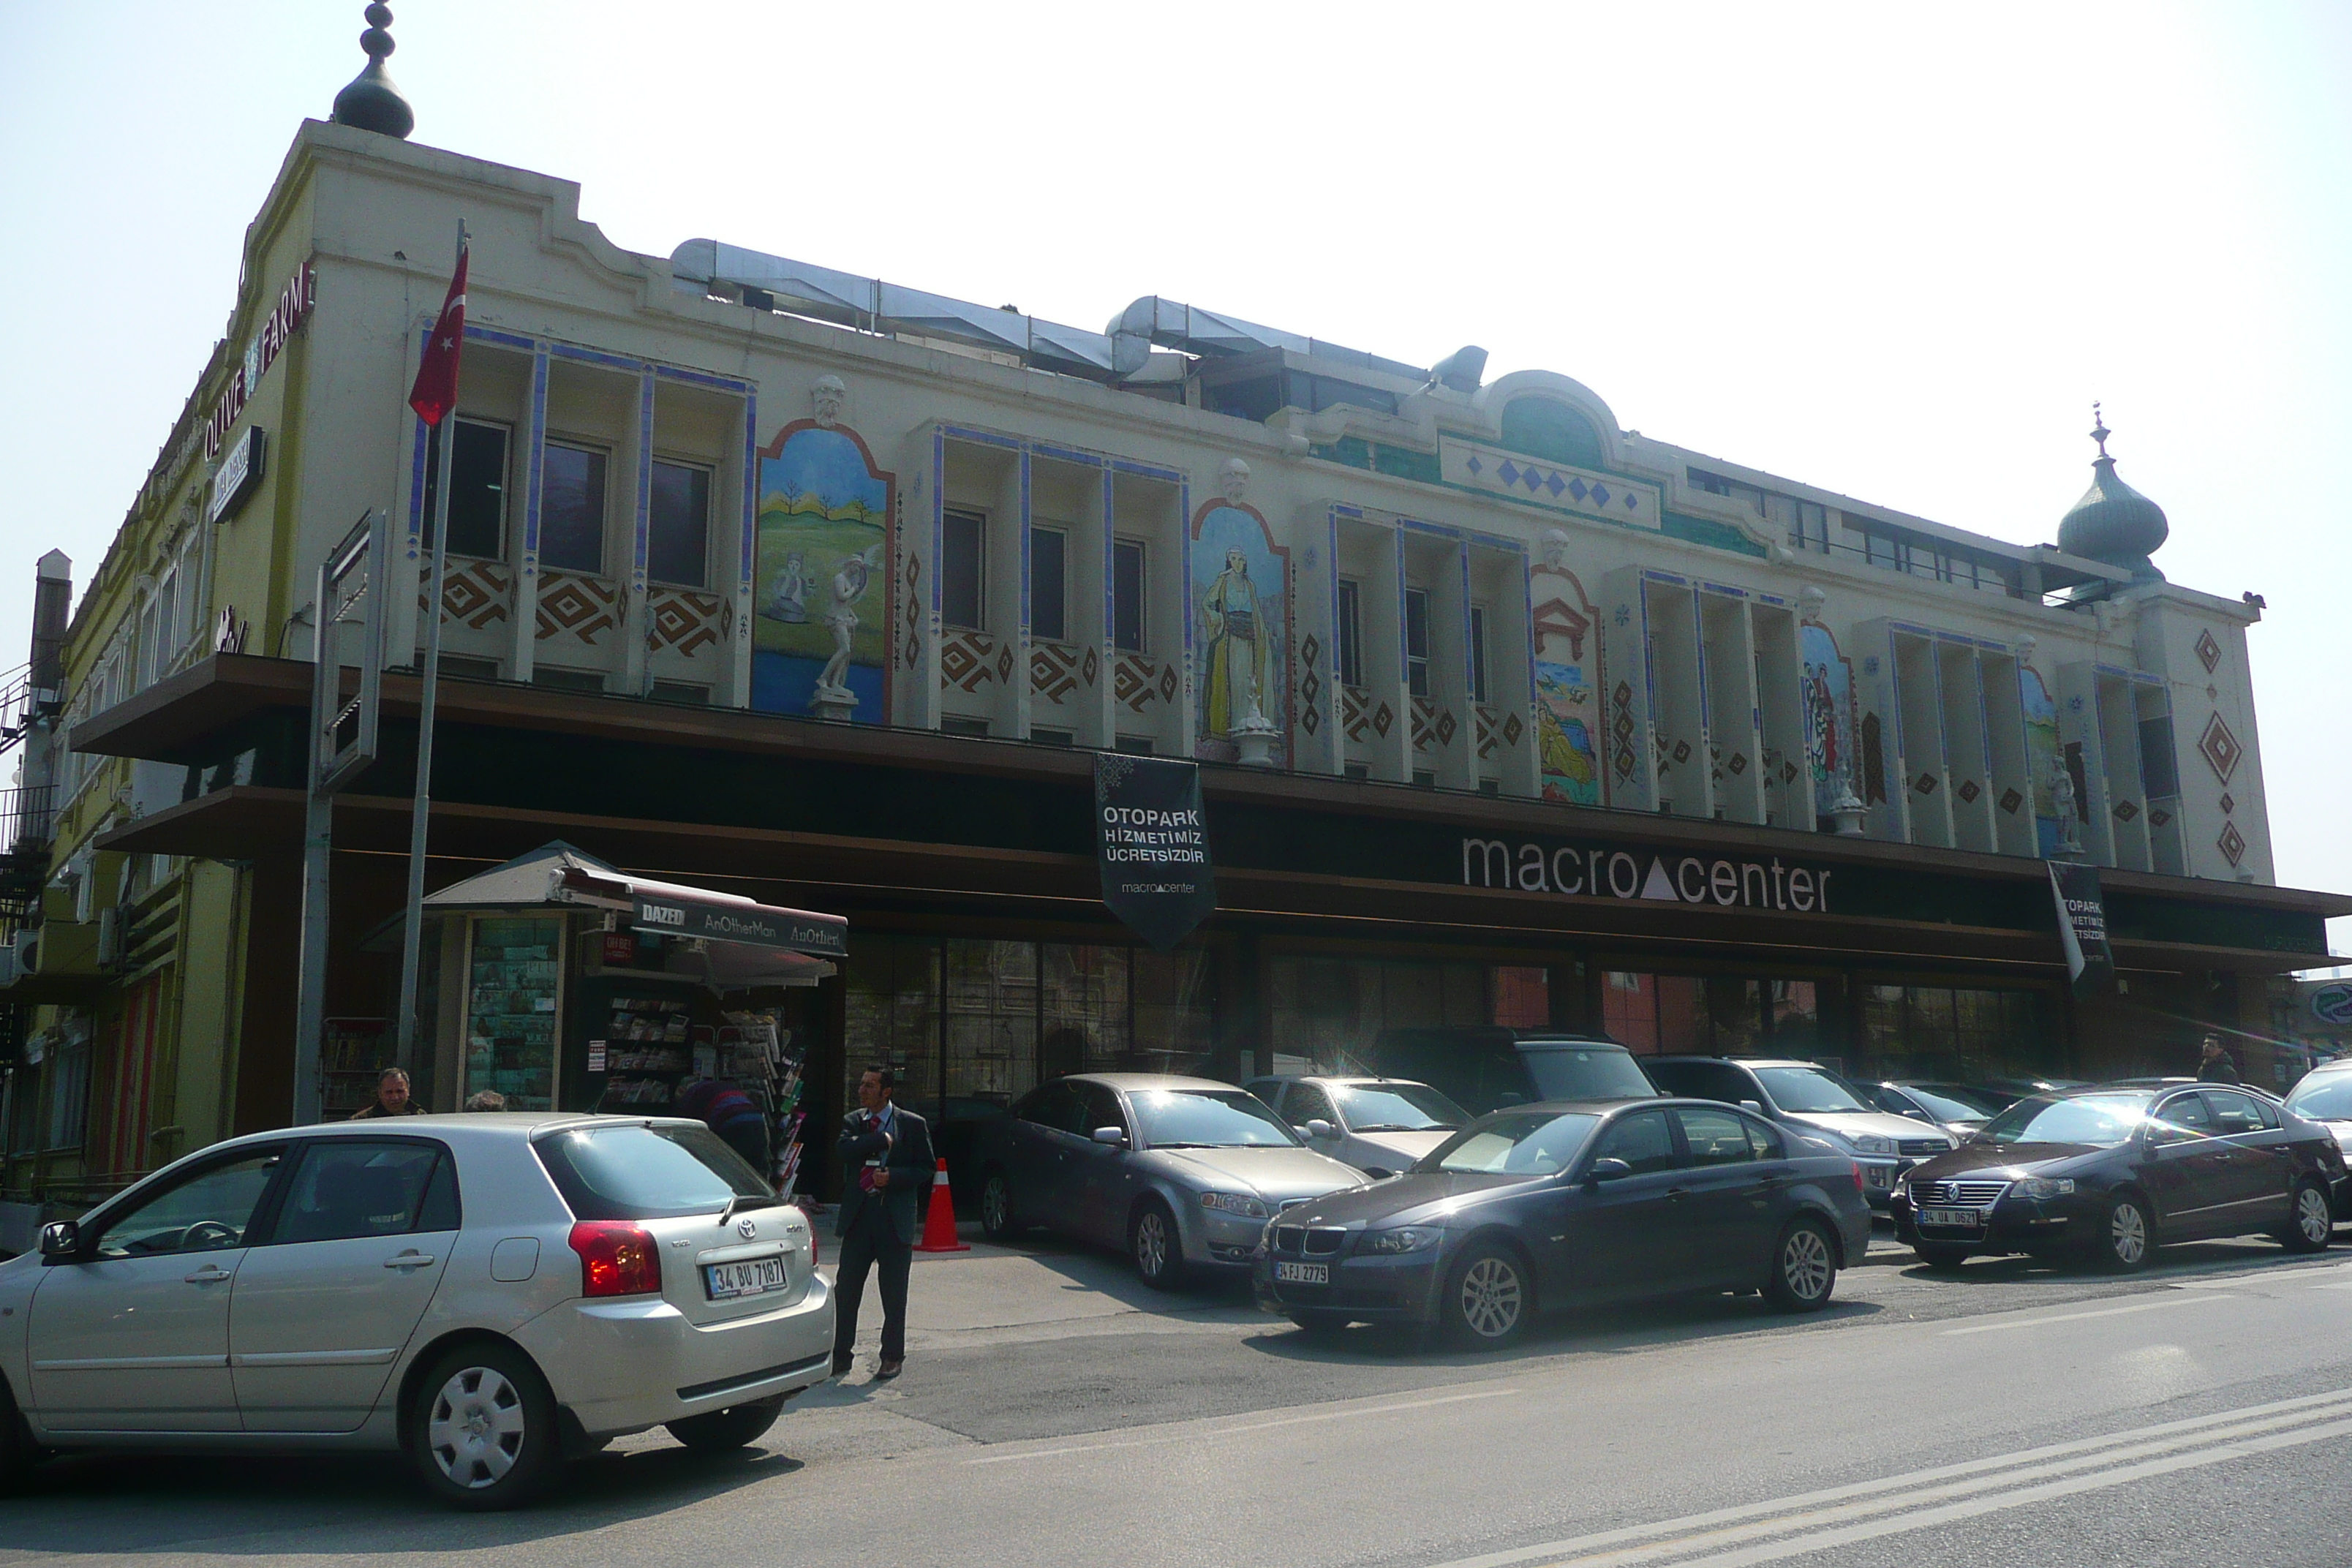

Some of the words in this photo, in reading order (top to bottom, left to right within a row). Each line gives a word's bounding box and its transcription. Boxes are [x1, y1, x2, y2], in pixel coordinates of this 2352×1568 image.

[205, 368, 241, 463] OLIVE
[260, 261, 304, 374] FARM
[1104, 806, 1200, 827] OTOPARK
[1105, 827, 1202, 845] HİZMETİMİZ
[1107, 845, 1205, 864] ÜCRETSİZDİR
[705, 913, 777, 938] AnOtherMan
[1923, 1211, 1934, 1222] 34
[1937, 1211, 1949, 1223] UA
[715, 1267, 734, 1290] 34
[736, 1263, 753, 1287] BU
[754, 1260, 780, 1286] 7187
[1278, 1263, 1287, 1278] 34
[1289, 1264, 1299, 1279] FJ
[1303, 1265, 1327, 1281] 2779
